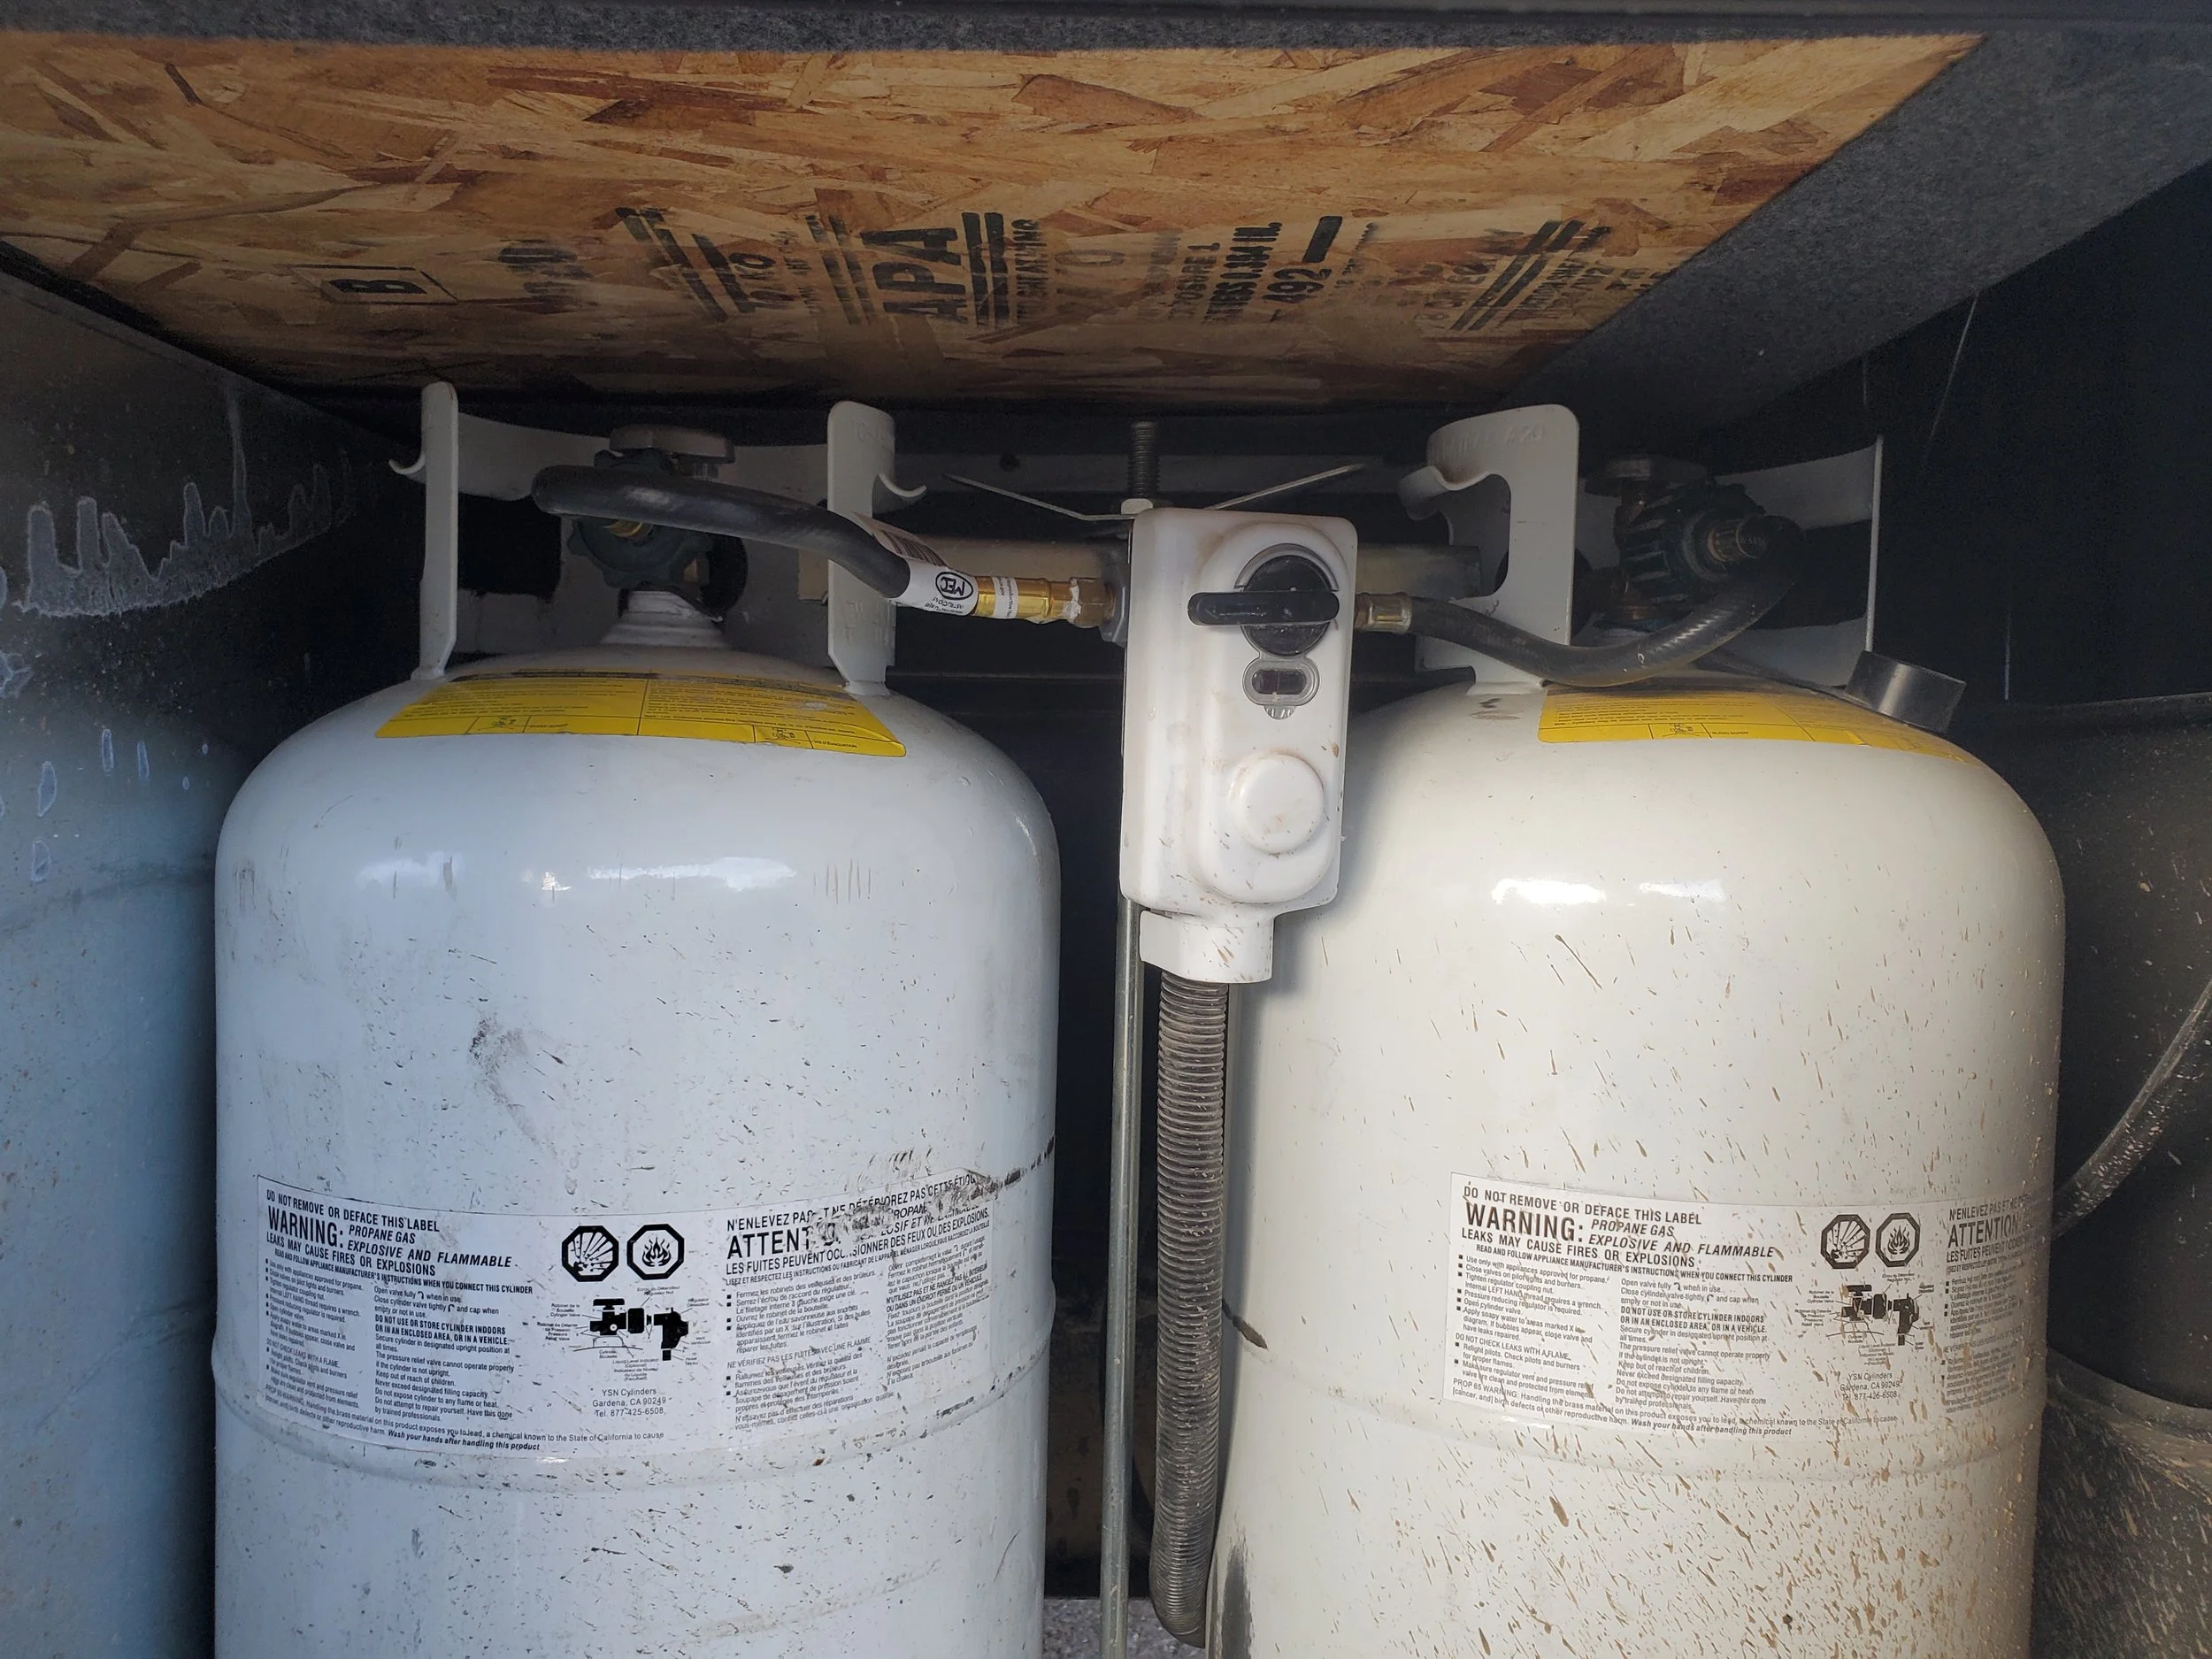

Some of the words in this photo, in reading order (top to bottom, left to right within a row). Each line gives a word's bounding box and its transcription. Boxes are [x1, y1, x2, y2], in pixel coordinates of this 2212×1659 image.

[861, 227, 968, 324] APA
[1261, 268, 1332, 303] 492
[941, 576, 964, 596] MEC
[267, 1189, 275, 1202] DO
[279, 1193, 291, 1206] NOT
[294, 1198, 324, 1215] REMOVE
[329, 1206, 340, 1218] OR
[344, 1210, 378, 1225] DEFACE
[382, 1216, 403, 1228] THIS
[407, 1218, 439, 1232] LABEL
[1464, 1187, 1478, 1198] DO
[1485, 1190, 1506, 1202] NOT
[1509, 1194, 1556, 1210] REMOVE
[1563, 1202, 1579, 1214] OR
[1586, 1204, 1629, 1218] DEFACE
[1634, 1209, 1662, 1221] THIS
[1665, 1212, 1701, 1225] LABEL
[1949, 1204, 1988, 1221] N'ENLEVEZ
[268, 1205, 343, 1248] WARNING:
[349, 1225, 393, 1240] PROPANE
[396, 1232, 416, 1244] GAS
[727, 1214, 789, 1231] N'ENLEVEZ
[1466, 1202, 1583, 1242] WARNING:
[1591, 1219, 1647, 1234] PROPANE
[1651, 1225, 1674, 1237] GAS
[267, 1232, 284, 1248] LEAKS
[288, 1239, 302, 1252] MAY
[305, 1244, 328, 1260] CAUSE
[333, 1251, 355, 1265] FIRES
[360, 1256, 372, 1268] OR
[377, 1258, 435, 1276] EXPLOSIONS
[348, 1240, 403, 1258] EXPLOSIVE
[408, 1249, 431, 1261] AND
[437, 1252, 511, 1267] FLAMMABLE
[726, 1263, 743, 1275] LES
[747, 1258, 780, 1272] FUITES
[783, 1250, 825, 1268] PEUVENT
[891, 1234, 905, 1248] DES
[908, 1230, 926, 1244] FEUX
[927, 1225, 938, 1239] OU
[939, 1221, 950, 1235] DES
[953, 1208, 989, 1230] EXPLOSIONS.
[1462, 1227, 1493, 1243] LEAKS
[1499, 1234, 1521, 1248] MAY
[1527, 1240, 1562, 1254] CAUSE
[1567, 1245, 1598, 1258] FIRES
[1605, 1250, 1619, 1261] OR
[1589, 1234, 1658, 1250] EXPLOSIVE
[1664, 1241, 1691, 1254] AND
[1698, 1243, 1774, 1257] FLAMMABLE
[1477, 1244, 1492, 1253] READ
[1494, 1247, 1505, 1256] AND
[1508, 1249, 1532, 1260] FOLLOW
[1533, 1254, 1569, 1265] APPLIANCE
[1571, 1260, 1629, 1273] MANUFACTURER'S
[1631, 1265, 1678, 1278] INSTRUCTIONS
[1701, 1271, 1714, 1280] YOU
[1716, 1272, 1745, 1281] CONNECT
[1947, 1249, 1959, 1263] LES
[1960, 1247, 1980, 1261] FUITES
[275, 1248, 284, 1258] READ
[293, 1255, 309, 1265] FOLLOW
[310, 1258, 334, 1271] APPLIANCE
[334, 1265, 380, 1280] MANUFACTURER'S
[380, 1274, 421, 1286] INSTRUCTIONS
[423, 1279, 440, 1287] WHEN
[455, 1282, 483, 1291] CONNECT
[501, 1285, 533, 1294] CYLINDER
[750, 1272, 781, 1283] RESPECTEZ
[794, 1264, 831, 1278] INSTRUCTIONS
[374, 1286, 388, 1295] Open
[404, 1290, 416, 1299] fully
[375, 1314, 383, 1323] DO
[385, 1316, 396, 1325] NOT
[420, 1320, 440, 1330] STORE
[442, 1323, 473, 1333] CYLINDER
[475, 1325, 505, 1334] INDOORS
[1632, 1307, 1646, 1316] NOT
[1698, 1313, 1732, 1322] CYLINDER
[375, 1324, 383, 1333] OR
[401, 1328, 432, 1339] ENCLOSED
[434, 1332, 452, 1341] AREA,
[621, 1388, 657, 1397] Cylinders
[445, 1437, 461, 1446] after
[462, 1440, 494, 1449] handling
[511, 1442, 540, 1451] product
